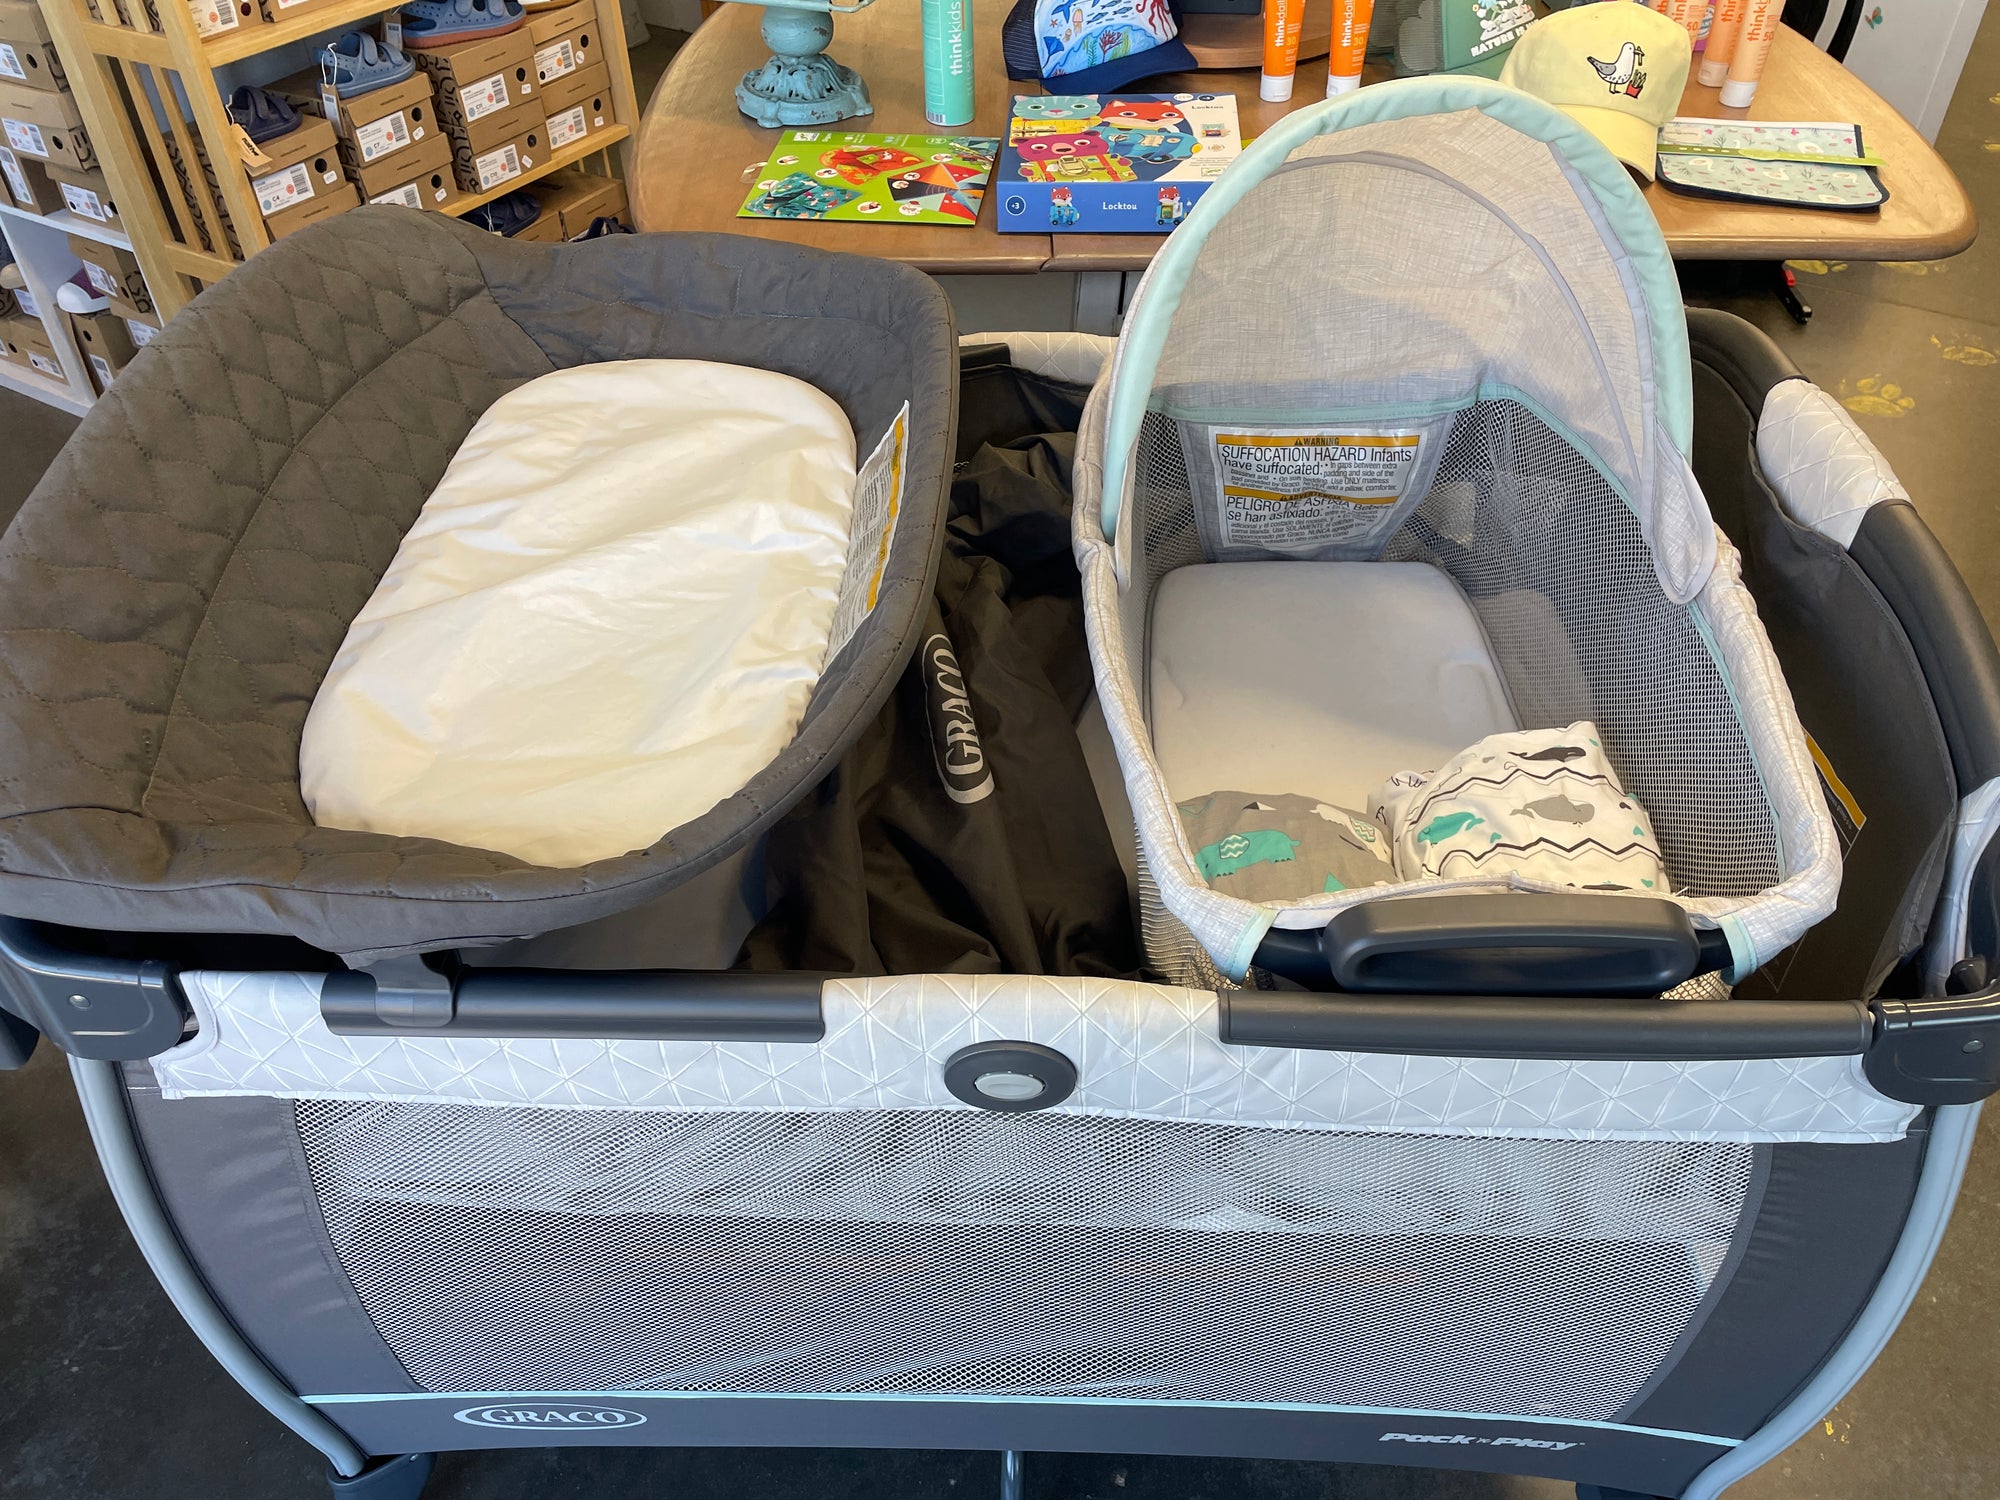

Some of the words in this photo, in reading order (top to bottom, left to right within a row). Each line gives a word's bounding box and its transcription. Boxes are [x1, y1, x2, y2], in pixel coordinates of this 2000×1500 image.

[1275, 0, 1287, 47] thinkdail
[1342, 0, 1353, 47] thinkdail
[1686, 21, 1698, 31] 50
[948, 1, 963, 76] thinkkids
[1470, 31, 1515, 57] NATURE
[1102, 202, 1138, 210] Locktou
[1304, 438, 1340, 446] WARNING
[1222, 446, 1310, 462] SUFFOCATION
[1314, 447, 1367, 462] HAZARD
[1371, 448, 1412, 462] Infants
[1224, 456, 1252, 470] have
[1338, 462, 1352, 470] gaps
[1344, 477, 1360, 485] ONLY
[1226, 496, 1282, 512] PELIGRO
[1284, 500, 1300, 510] DE
[1245, 511, 1266, 522] han
[933, 648, 984, 775] GRACO
[482, 1409, 626, 1424] GRACO
[1378, 1432, 1477, 1444] Pack
[1490, 1437, 1578, 1450] Play
